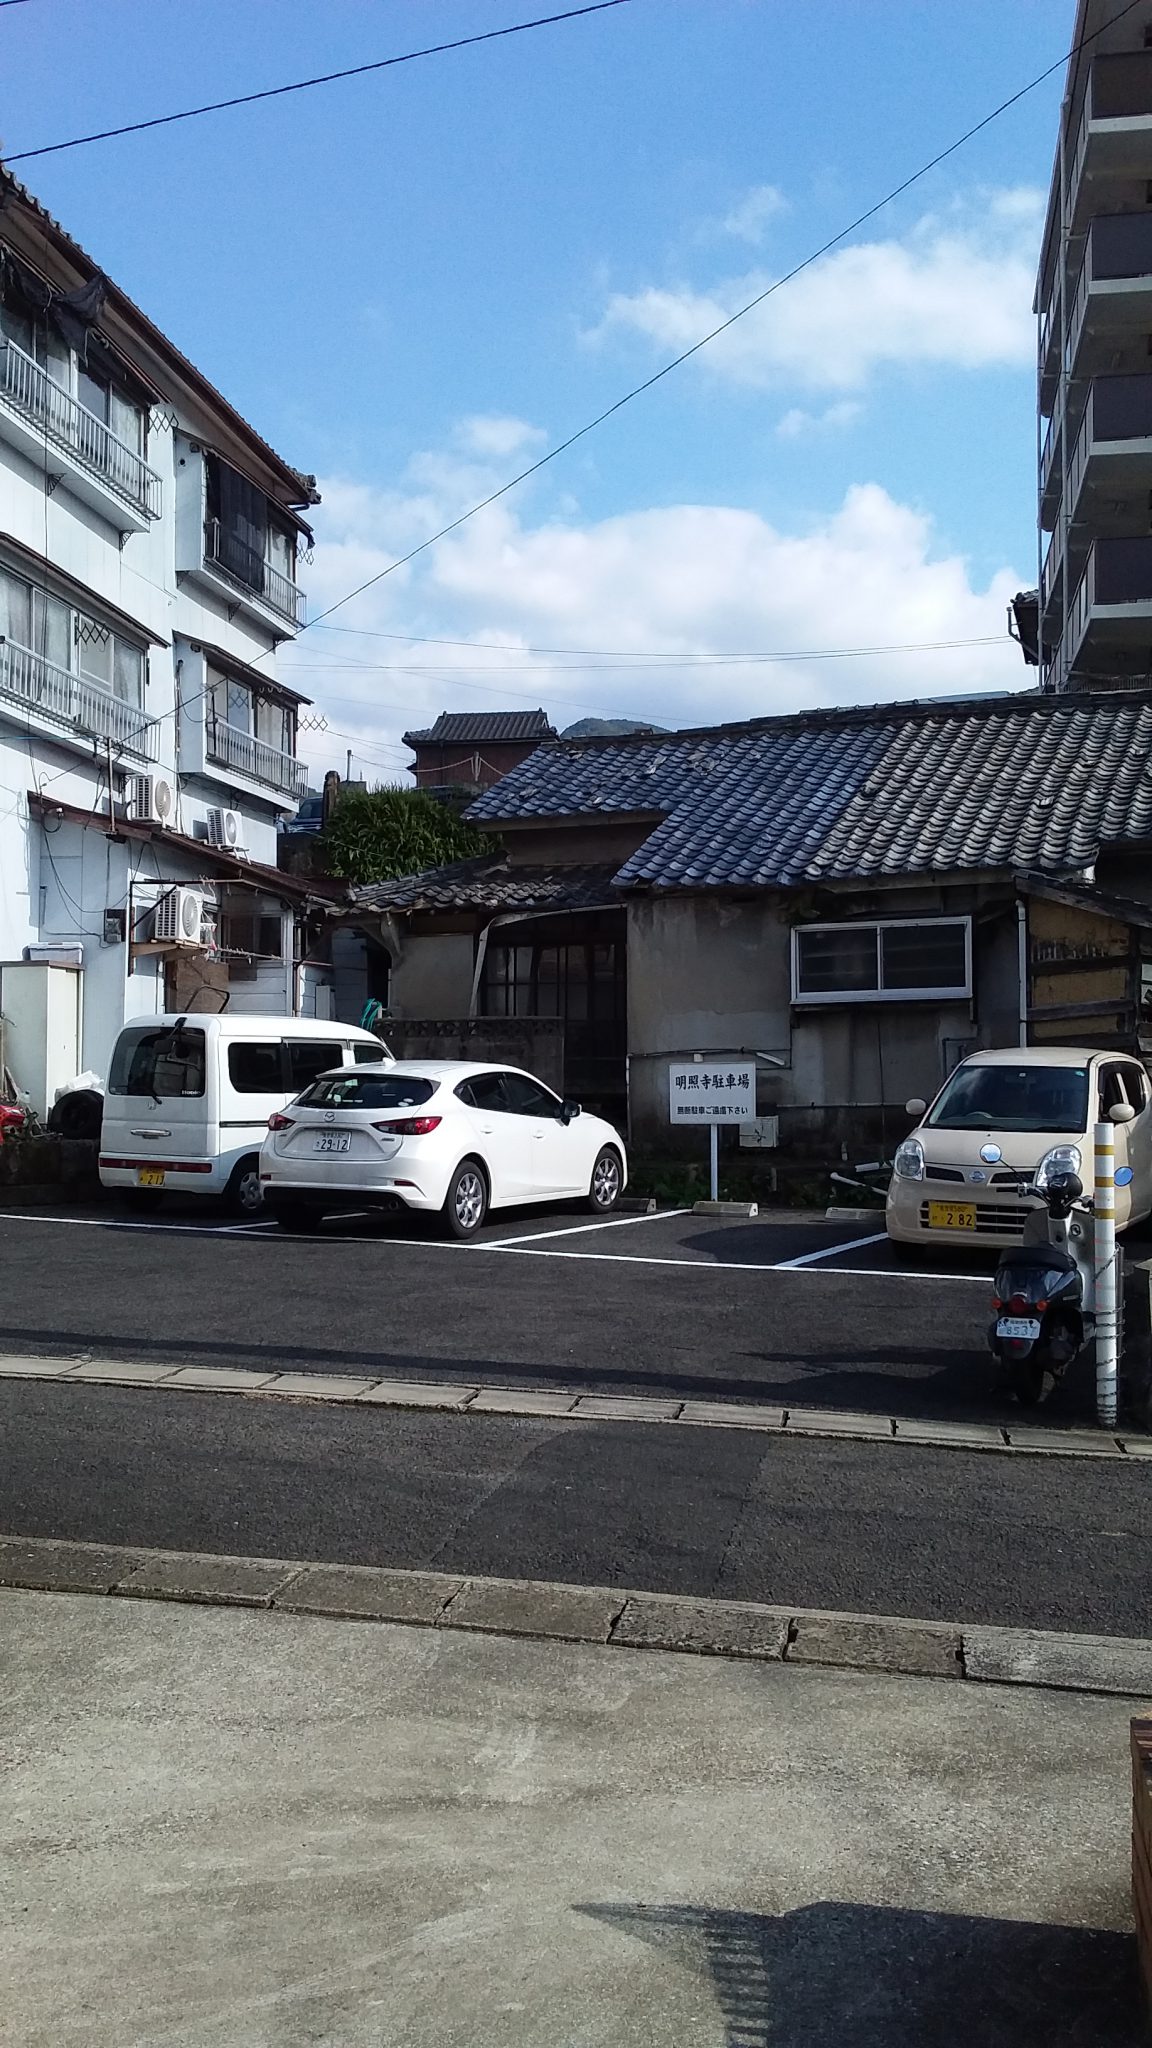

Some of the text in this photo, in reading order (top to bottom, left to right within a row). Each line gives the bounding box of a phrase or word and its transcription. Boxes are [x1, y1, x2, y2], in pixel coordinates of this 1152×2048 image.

[675, 1073, 750, 1090] 明照寺駐車場
